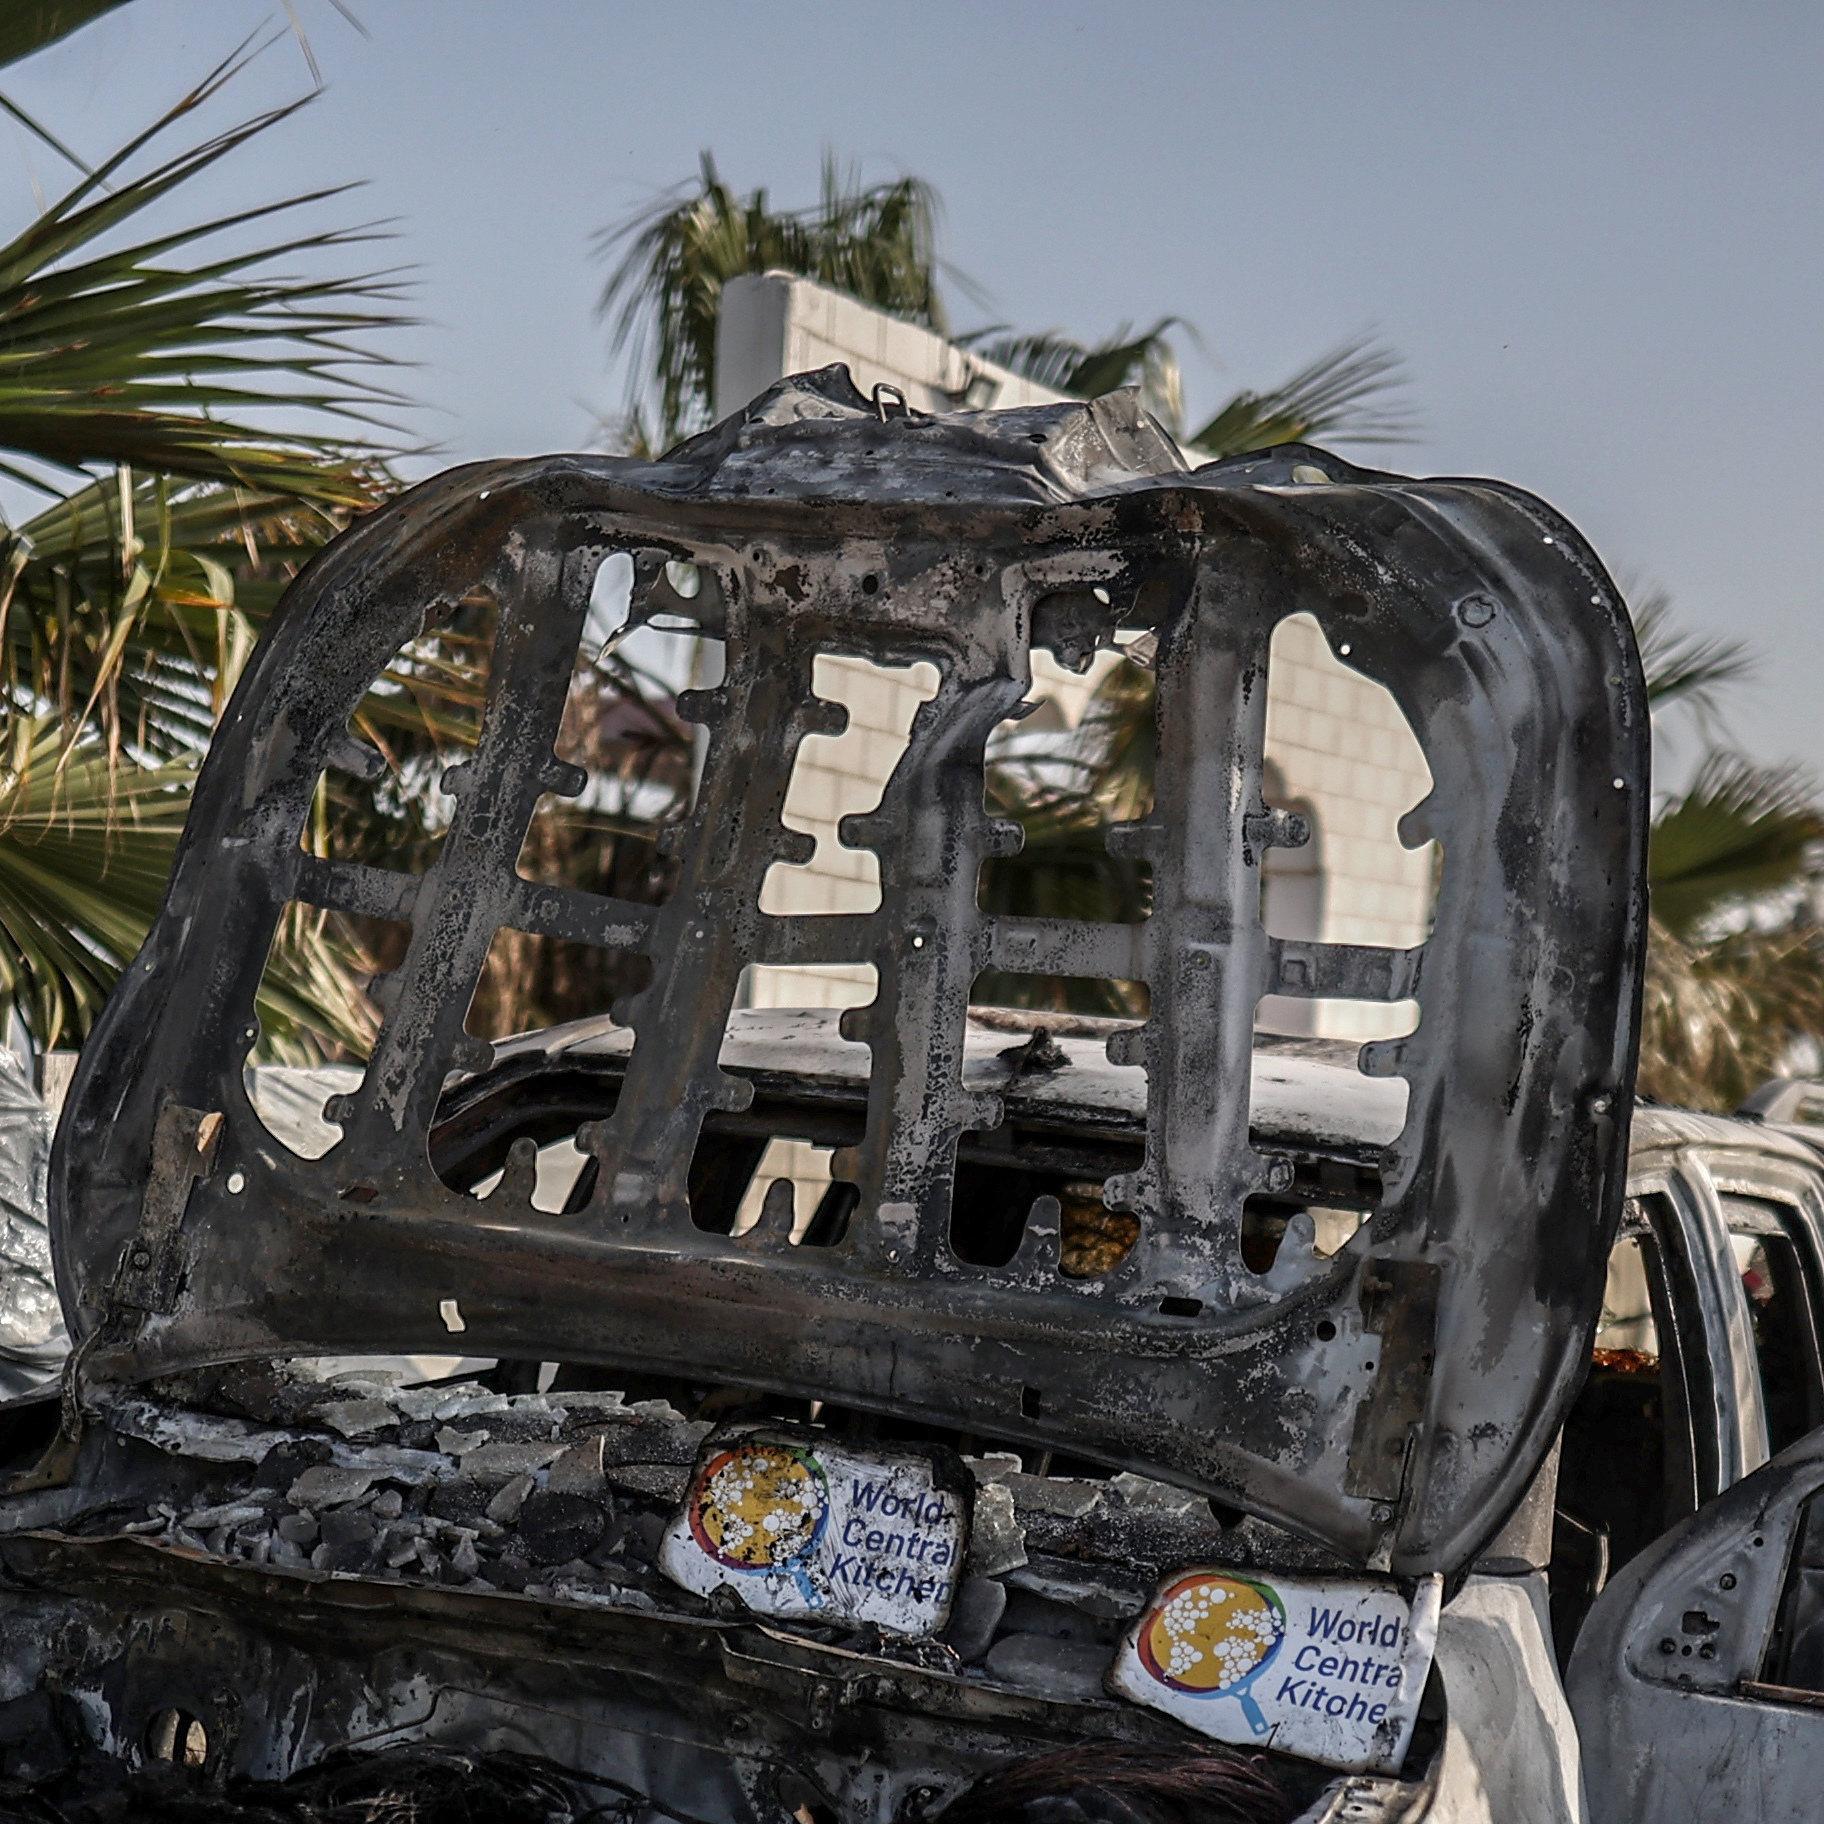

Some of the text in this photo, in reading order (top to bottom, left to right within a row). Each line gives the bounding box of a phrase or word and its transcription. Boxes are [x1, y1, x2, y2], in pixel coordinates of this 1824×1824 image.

[852, 1479, 945, 1525] World
[842, 1518, 959, 1567] Central
[1307, 1606, 1401, 1648] World
[1294, 1645, 1404, 1689] Centra
[1276, 1676, 1388, 1725] Kitche
